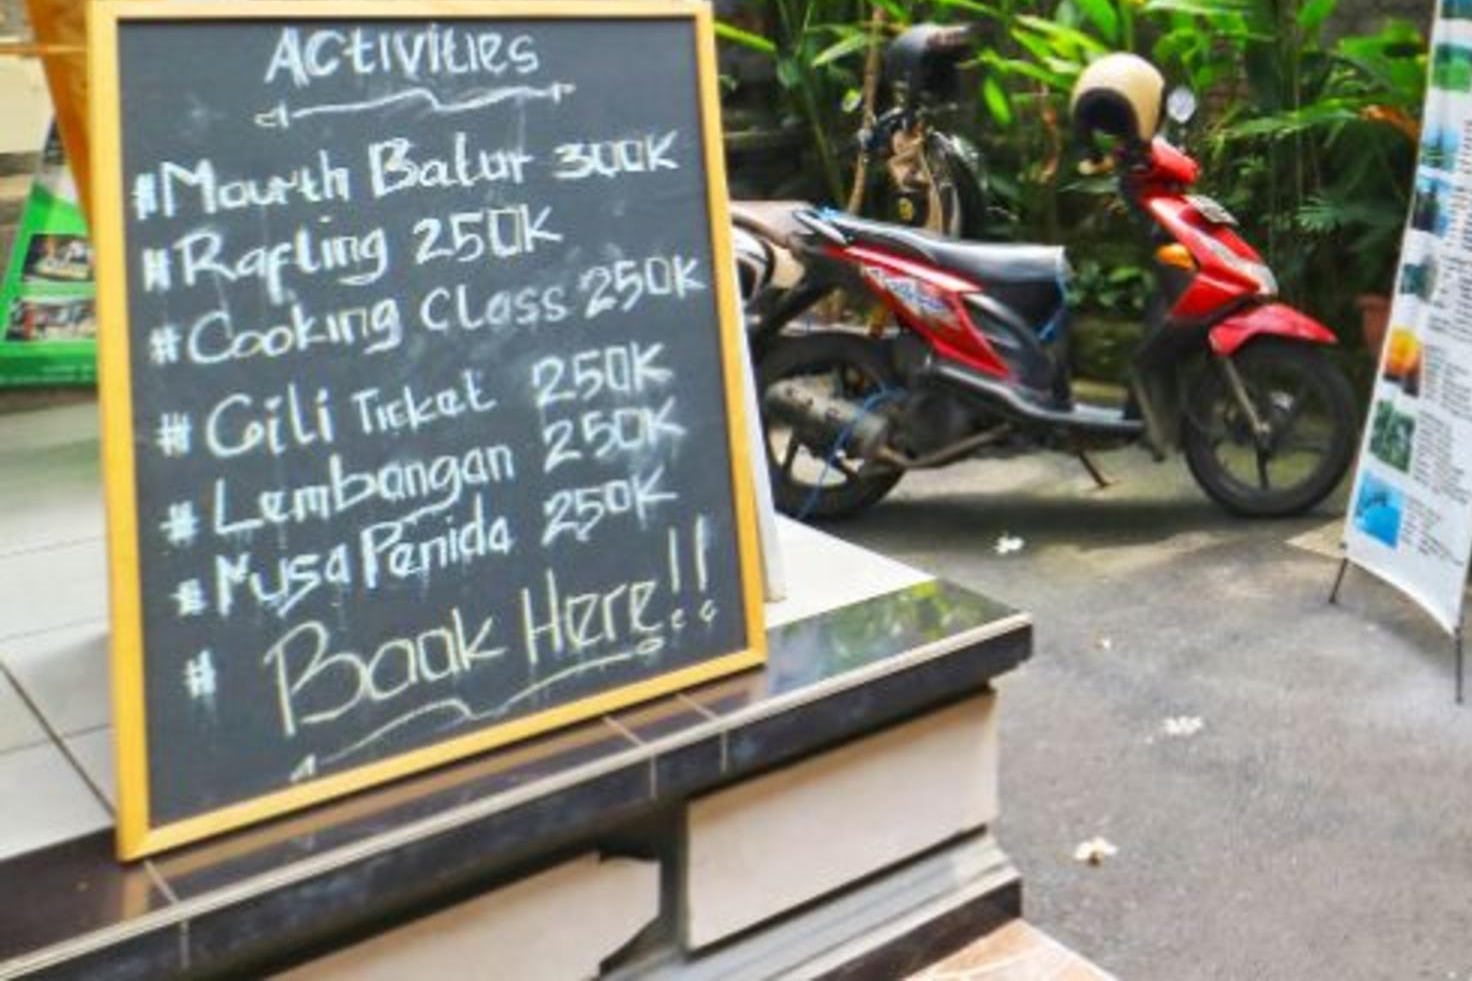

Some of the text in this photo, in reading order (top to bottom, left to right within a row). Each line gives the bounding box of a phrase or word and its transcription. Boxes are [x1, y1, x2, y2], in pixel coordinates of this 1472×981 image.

[553, 130, 680, 181] 300K
[413, 203, 564, 265] 250K
[577, 255, 707, 319] 250K
[205, 382, 335, 458] Gili
[351, 373, 498, 435] Ticket
[531, 342, 674, 407] 250K
[542, 395, 688, 473] 250K
[360, 491, 514, 589] Penida
[541, 465, 679, 546] 250K
[263, 605, 506, 737] Book
